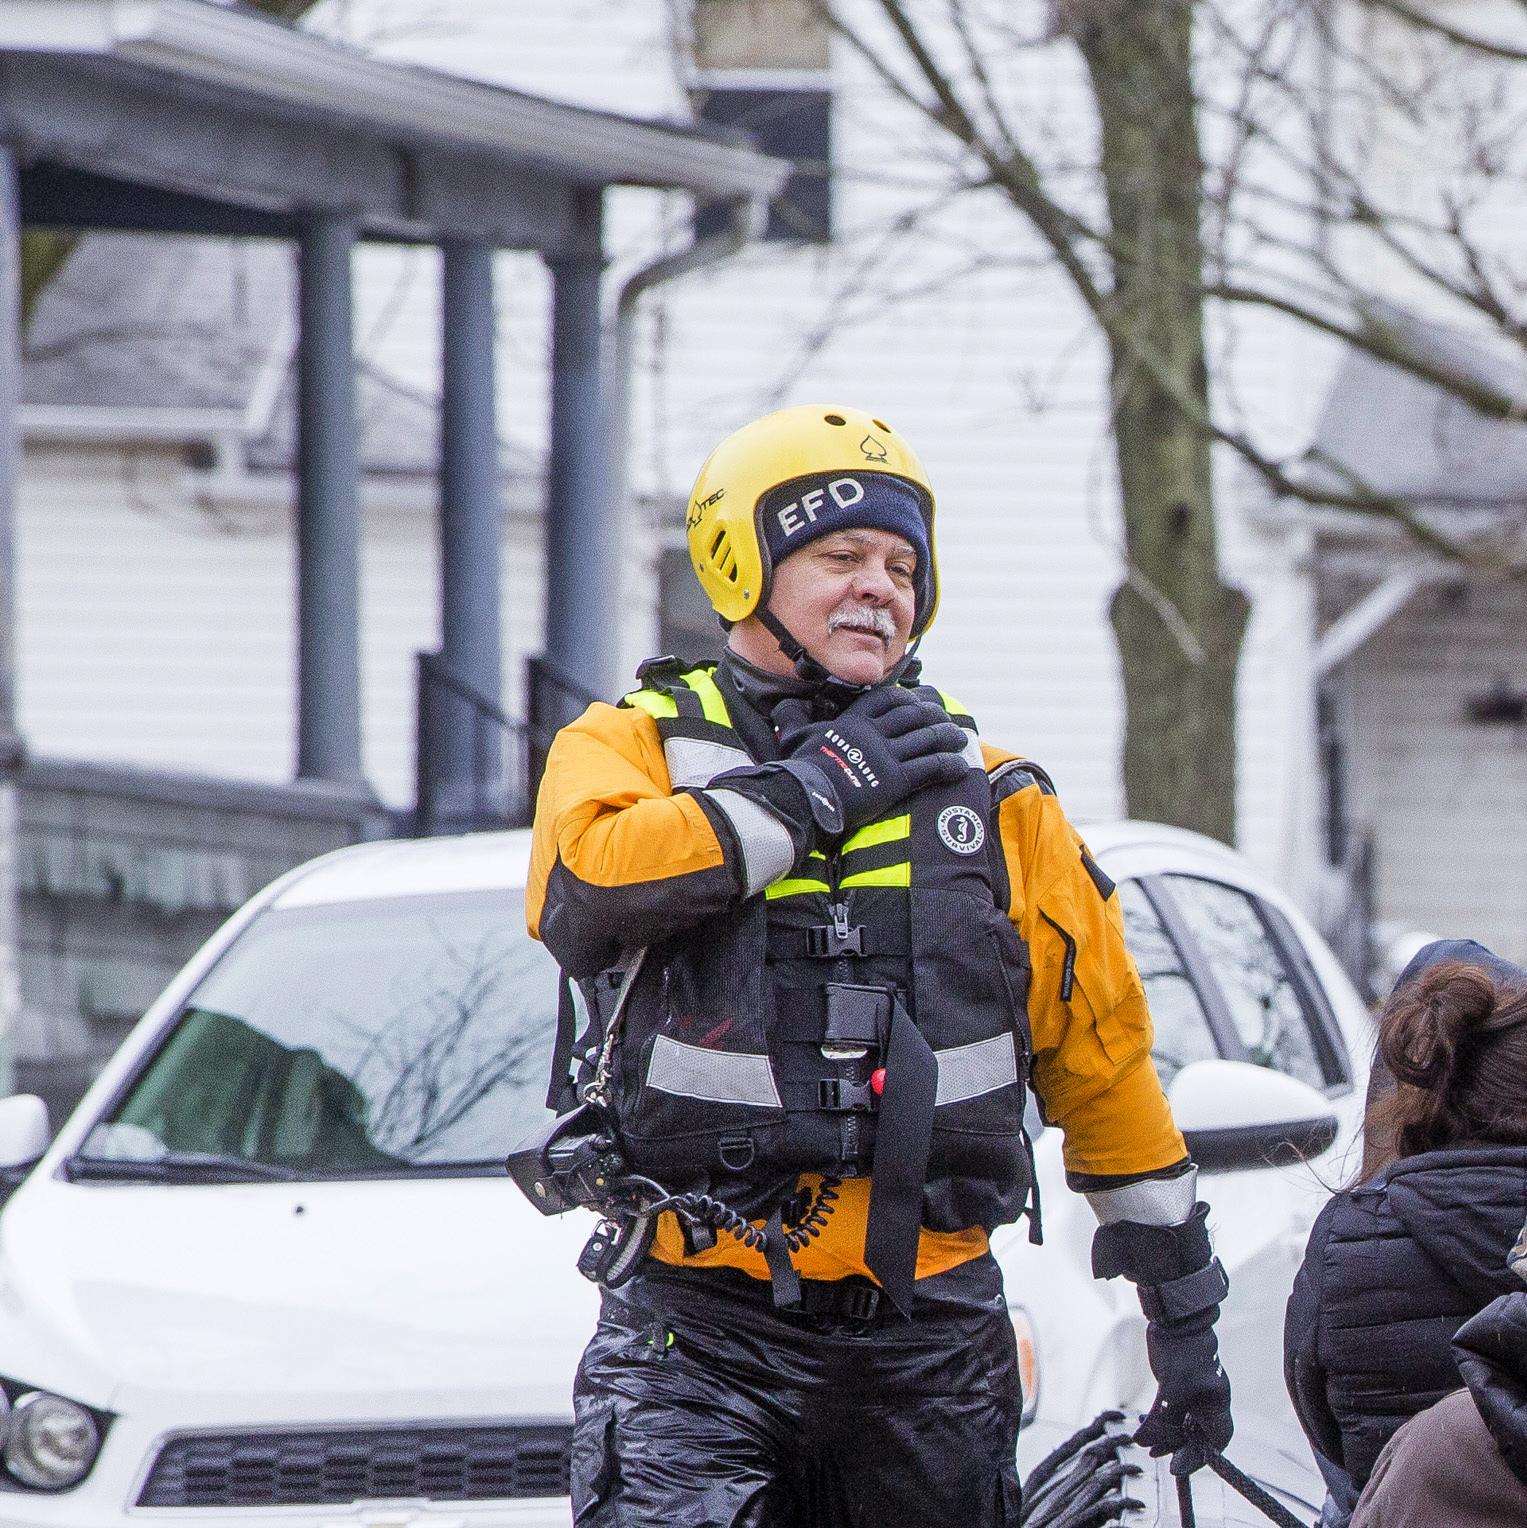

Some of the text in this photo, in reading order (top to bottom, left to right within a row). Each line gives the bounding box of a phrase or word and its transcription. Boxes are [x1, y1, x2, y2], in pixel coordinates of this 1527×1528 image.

[701, 488, 725, 510] TEC
[777, 478, 864, 537] EFD
[825, 729, 880, 788] AQUA LUNG
[940, 807, 983, 851] MUSTANG SURVIVAL
